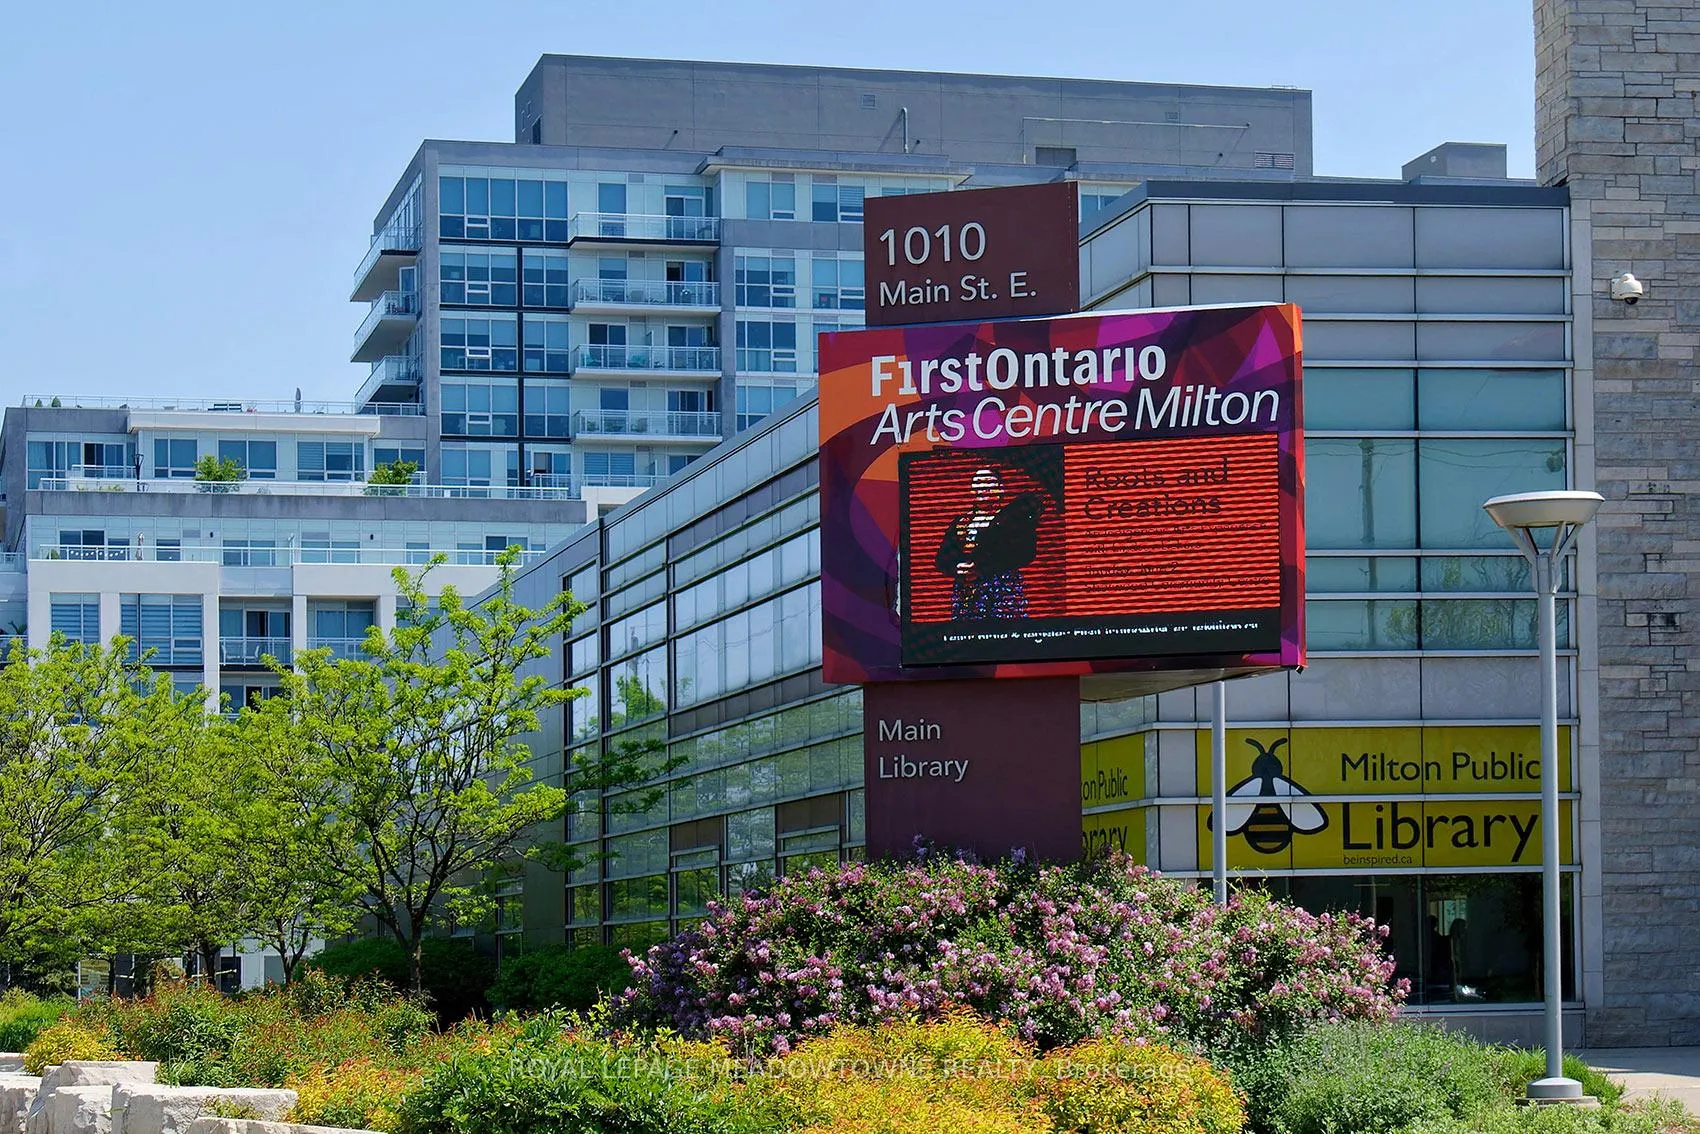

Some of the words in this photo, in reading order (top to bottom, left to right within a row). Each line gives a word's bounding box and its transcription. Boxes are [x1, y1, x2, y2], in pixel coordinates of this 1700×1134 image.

[879, 222, 987, 266] 1010
[879, 279, 950, 307] Main
[961, 274, 998, 301] St.
[1010, 271, 1037, 298] E.
[870, 402, 965, 446] Arts
[972, 392, 1128, 439] Centre
[1134, 384, 1280, 430] Milton
[1085, 466, 1166, 490] Roots
[1177, 456, 1229, 486] and
[1084, 493, 1222, 520] Creations
[878, 718, 942, 742] Main
[879, 754, 969, 783] Library
[1341, 752, 1442, 782] Milton
[1452, 751, 1542, 781] Public
[1098, 767, 1129, 800] Public
[1342, 801, 1539, 863] Library
[1343, 854, 1413, 867] beinspired.ca
